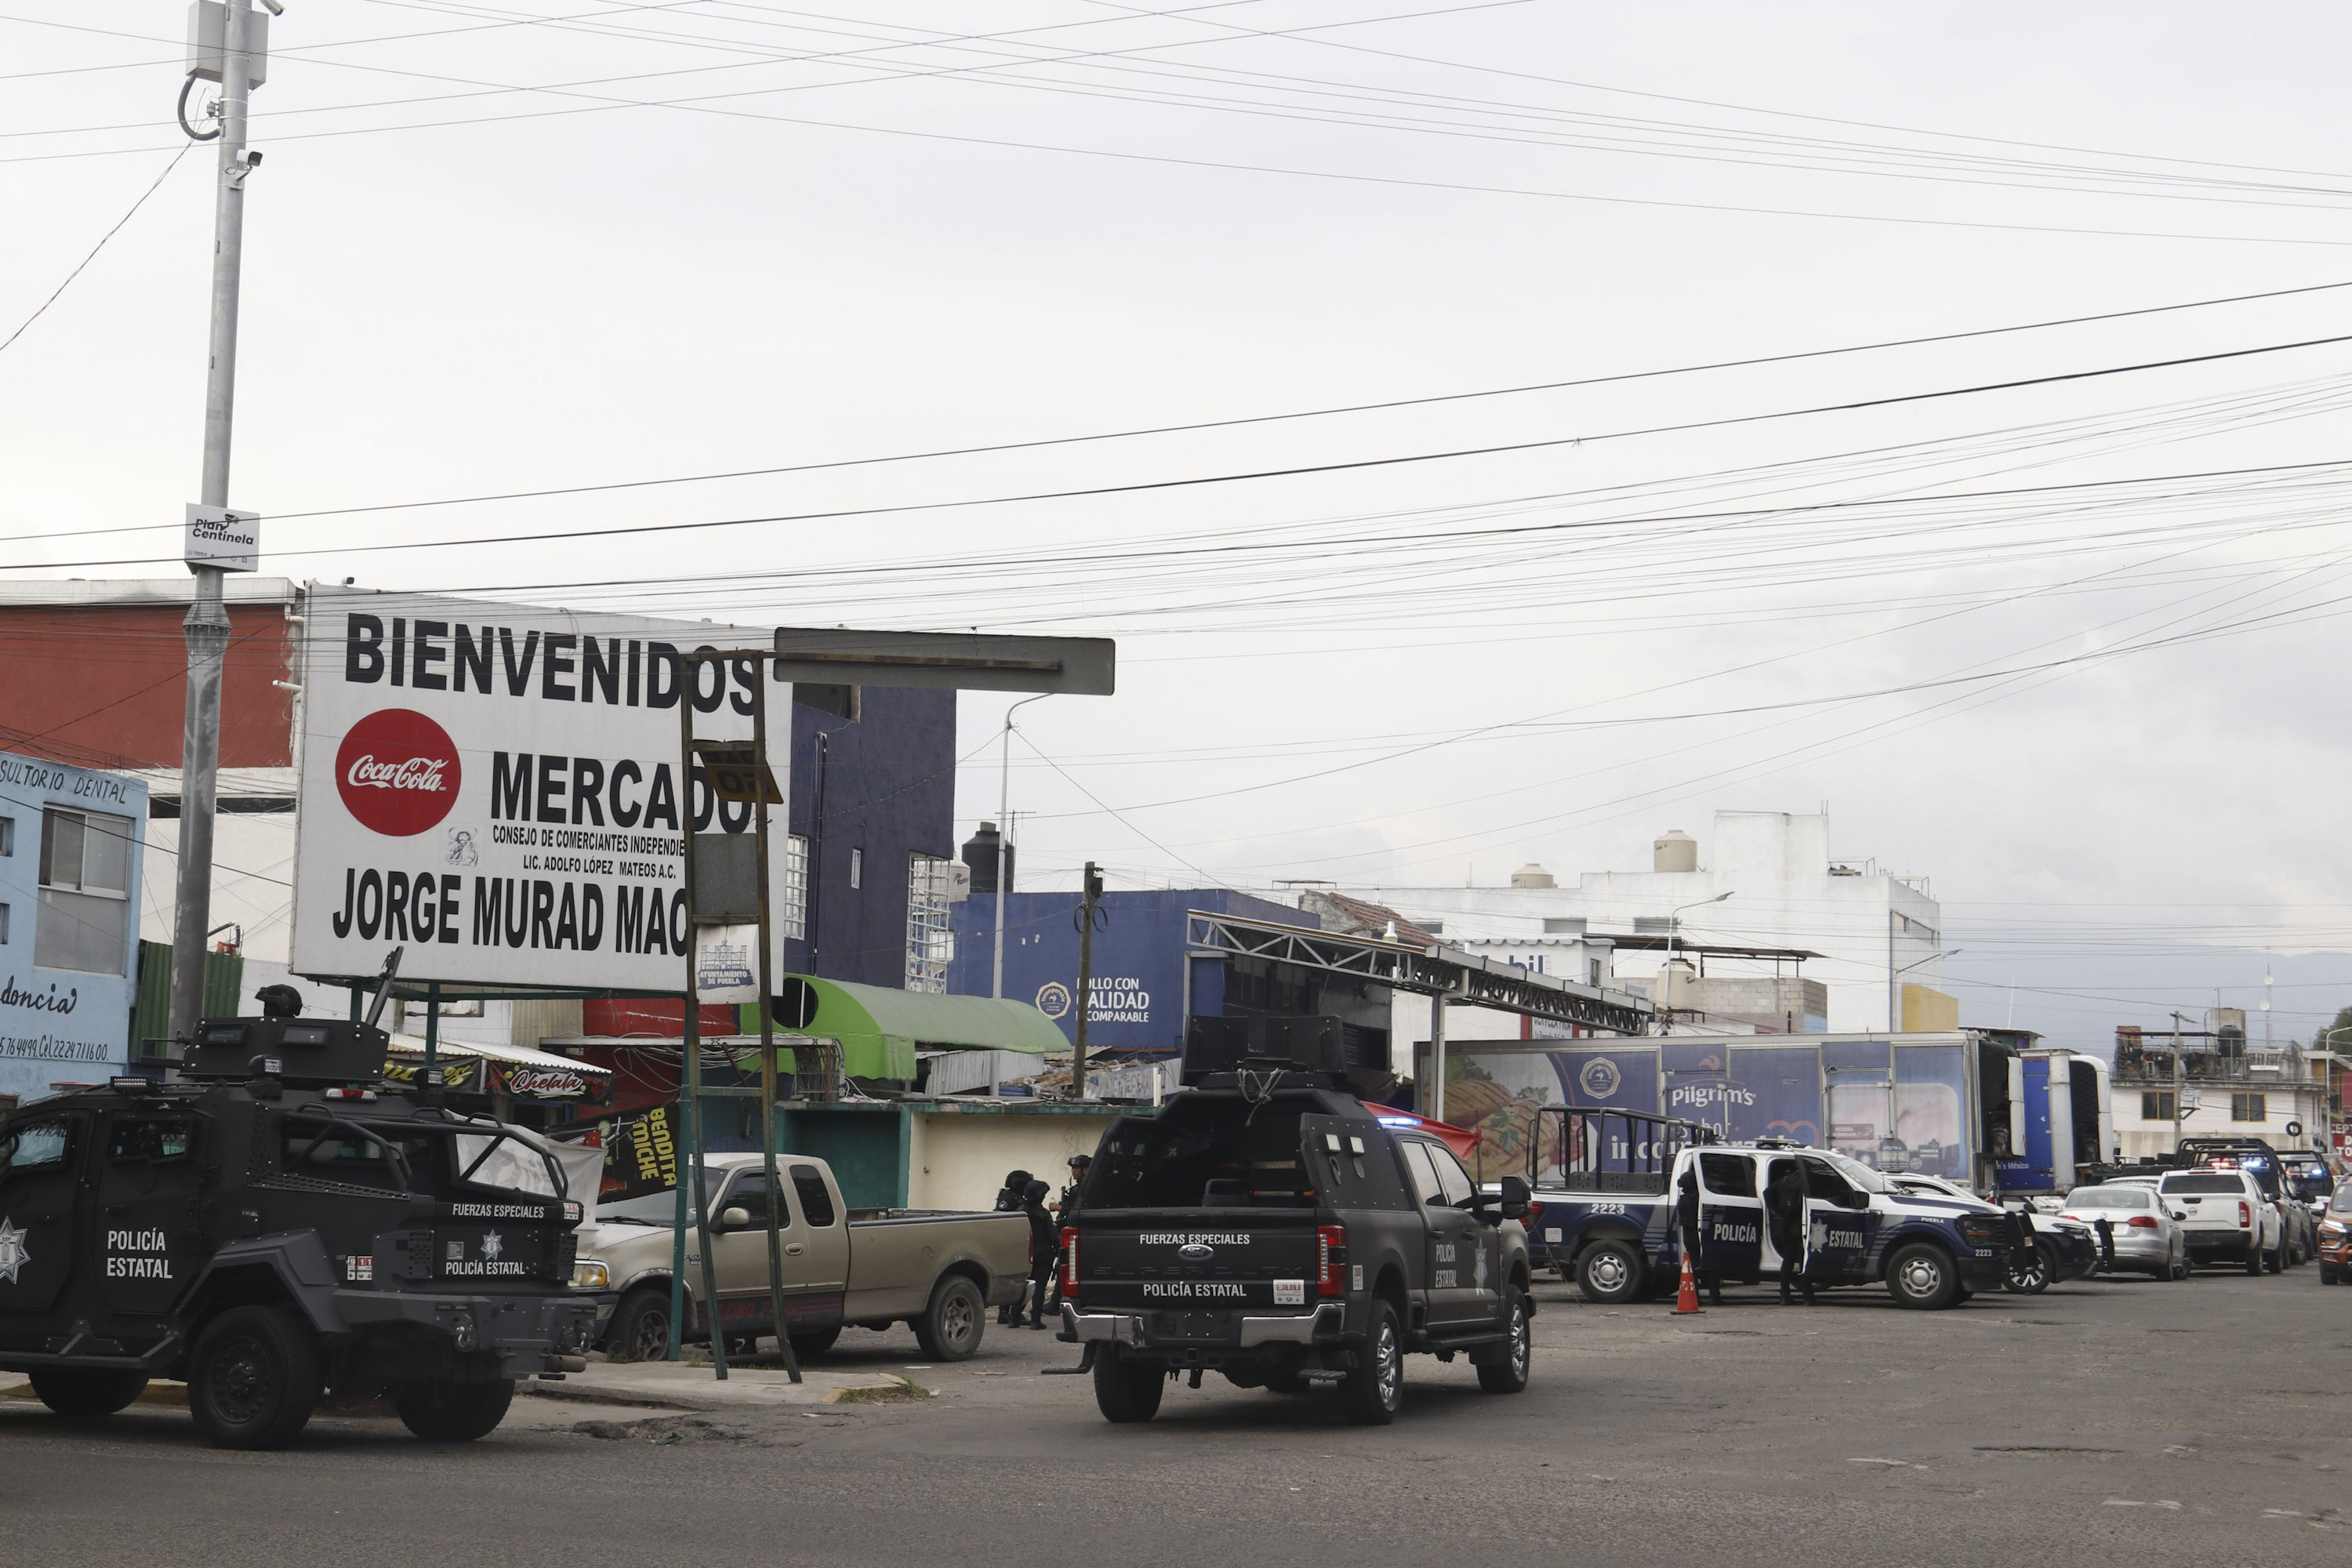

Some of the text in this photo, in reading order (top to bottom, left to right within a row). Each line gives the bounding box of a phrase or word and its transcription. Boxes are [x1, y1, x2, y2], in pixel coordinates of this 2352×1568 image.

[195, 518, 223, 531] Plan
[193, 528, 254, 545] Centinela
[346, 612, 755, 717] BIENVENIDOS
[347, 754, 449, 792] Coca-Cola
[74, 777, 125, 804] DENTAL
[493, 825, 684, 857] CONSEJO DE COMERCIANTES INDEPENDIE
[523, 855, 677, 879] LIC. ADOLFO LÓPEZ MATEOS A.C.
[332, 867, 462, 944] JORGE
[473, 876, 604, 950] MURAD
[1076, 977, 1139, 990] LLO CON
[1076, 991, 1150, 1010] ALIDAD
[1076, 1010, 1149, 1022] ICOMPARABLE
[510, 1069, 584, 1093] Chelala
[1671, 1083, 1754, 1107] Pilgrim's
[632, 1122, 660, 1181] MICHE
[649, 1107, 677, 1186] BENDITA
[452, 1203, 545, 1218] FUERZAS ESPECIALES
[1591, 1203, 1625, 1214] 2223
[107, 1227, 166, 1251] POLICÍA
[1139, 1233, 1250, 1245] FUERZAS ESPECIALES
[1714, 1222, 1757, 1243] POLICÍA
[1828, 1230, 1864, 1249] ESTATAL
[350, 1258, 372, 1266] 911
[1436, 1241, 1456, 1263] POLICÍA
[107, 1257, 173, 1279] ESTATAL
[445, 1259, 525, 1275] POLICÍA ESTATAL
[1276, 1283, 1301, 1291] 911
[1435, 1269, 1457, 1288] ESTATAL
[1143, 1281, 1247, 1297] POLICÍA ESTATAL
